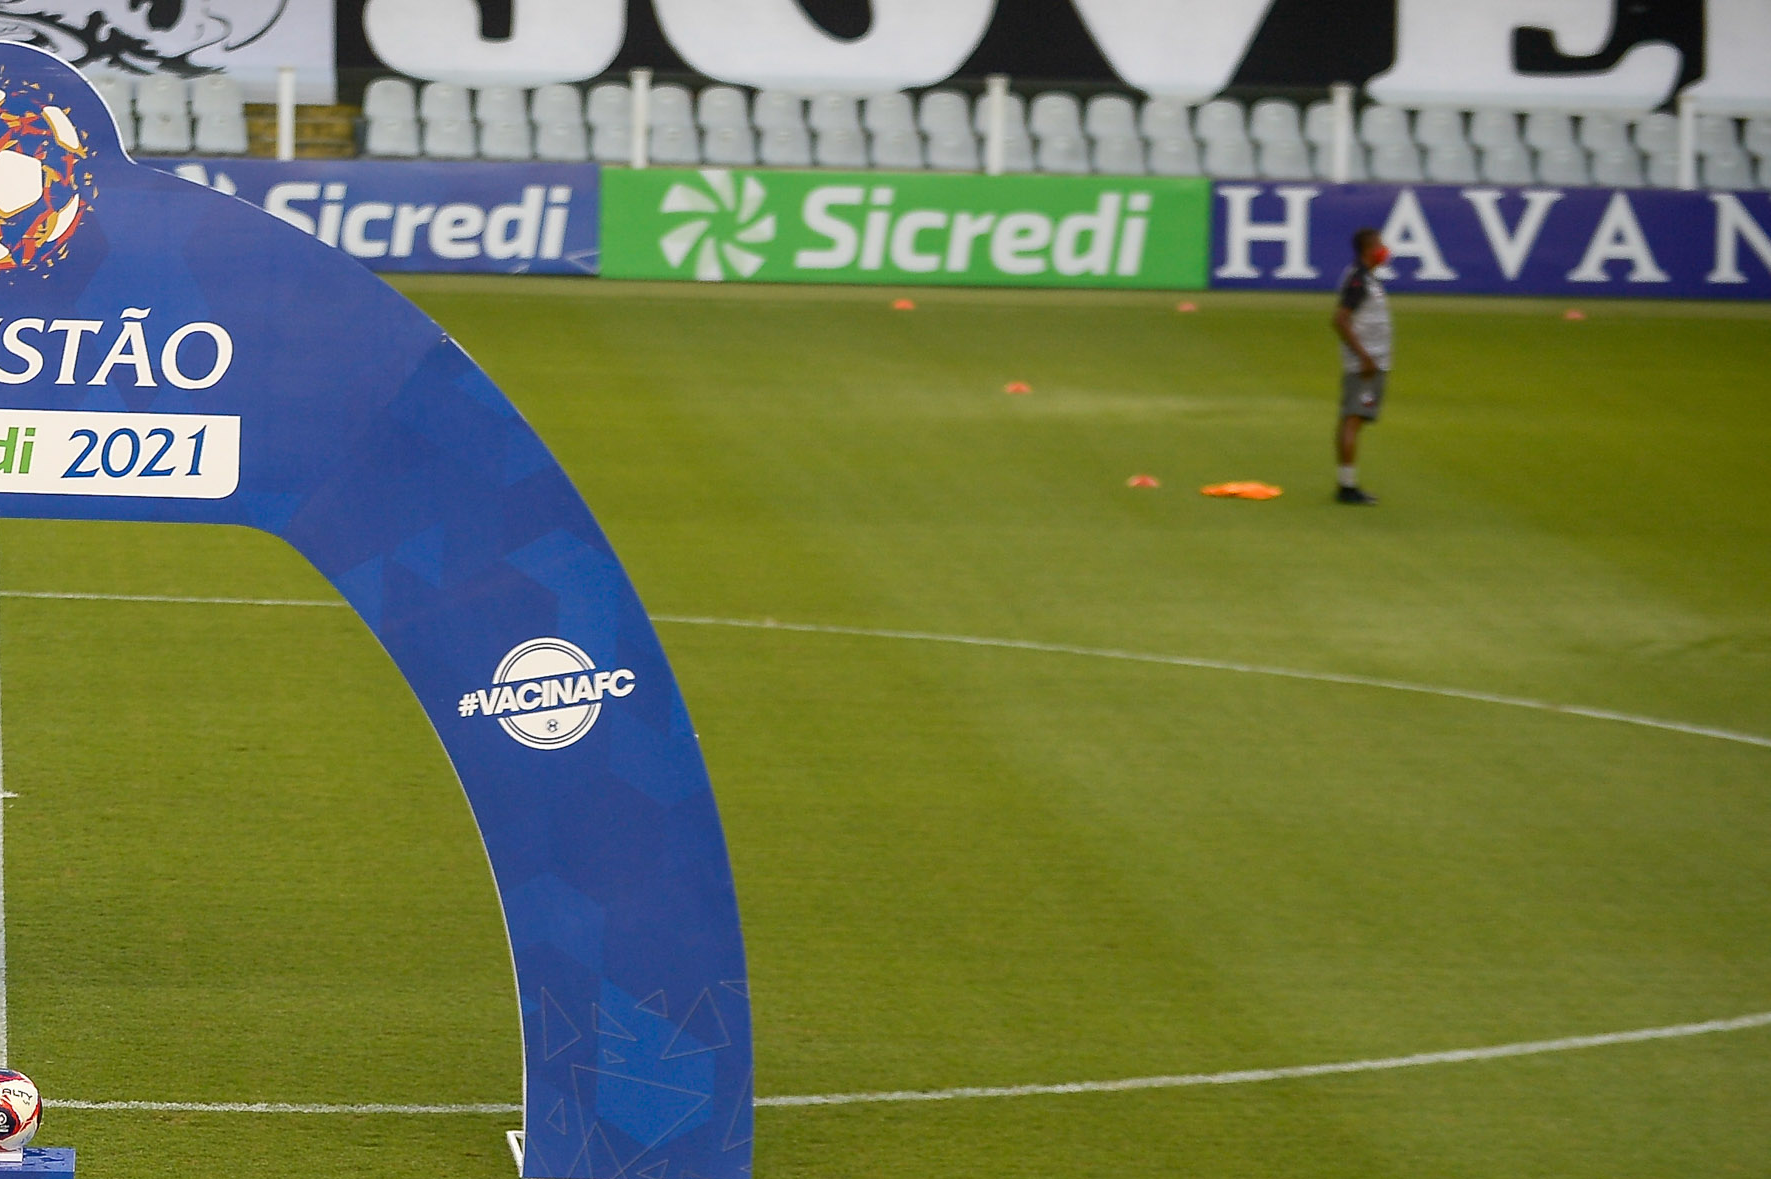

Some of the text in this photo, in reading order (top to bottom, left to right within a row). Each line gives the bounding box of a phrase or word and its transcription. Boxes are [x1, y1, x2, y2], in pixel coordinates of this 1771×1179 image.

[262, 181, 574, 260] Sicredi
[794, 185, 1153, 277] Sicredi
[60, 424, 208, 479] 2021
[457, 668, 636, 717] #VACINAFC
